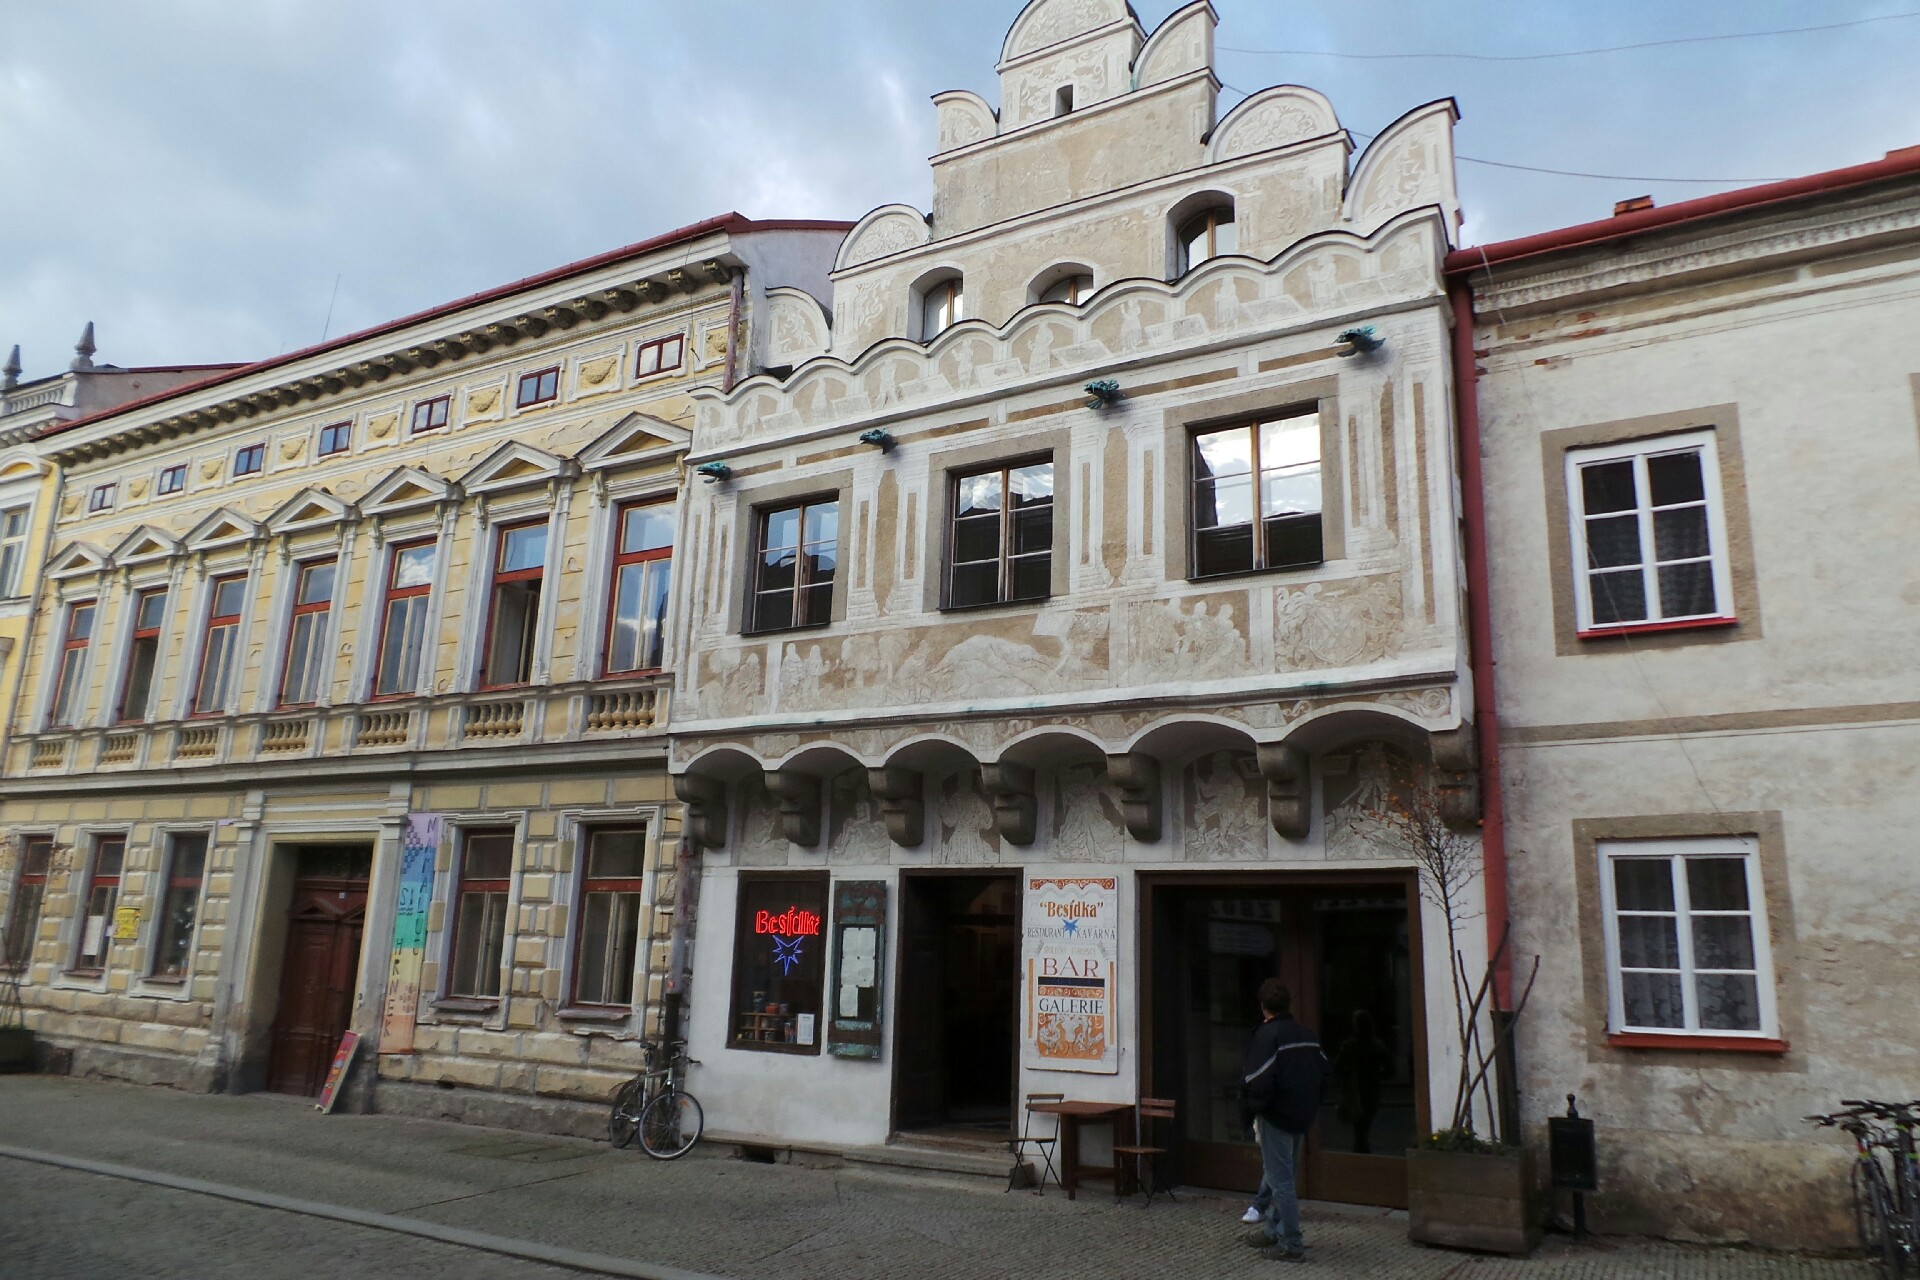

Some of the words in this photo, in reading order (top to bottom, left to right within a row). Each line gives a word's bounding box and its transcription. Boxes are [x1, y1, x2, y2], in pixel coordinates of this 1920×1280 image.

[1043, 955, 1099, 977] BAR
[383, 938, 403, 1038] HRNEK
[1039, 997, 1104, 1014] GALERIE
